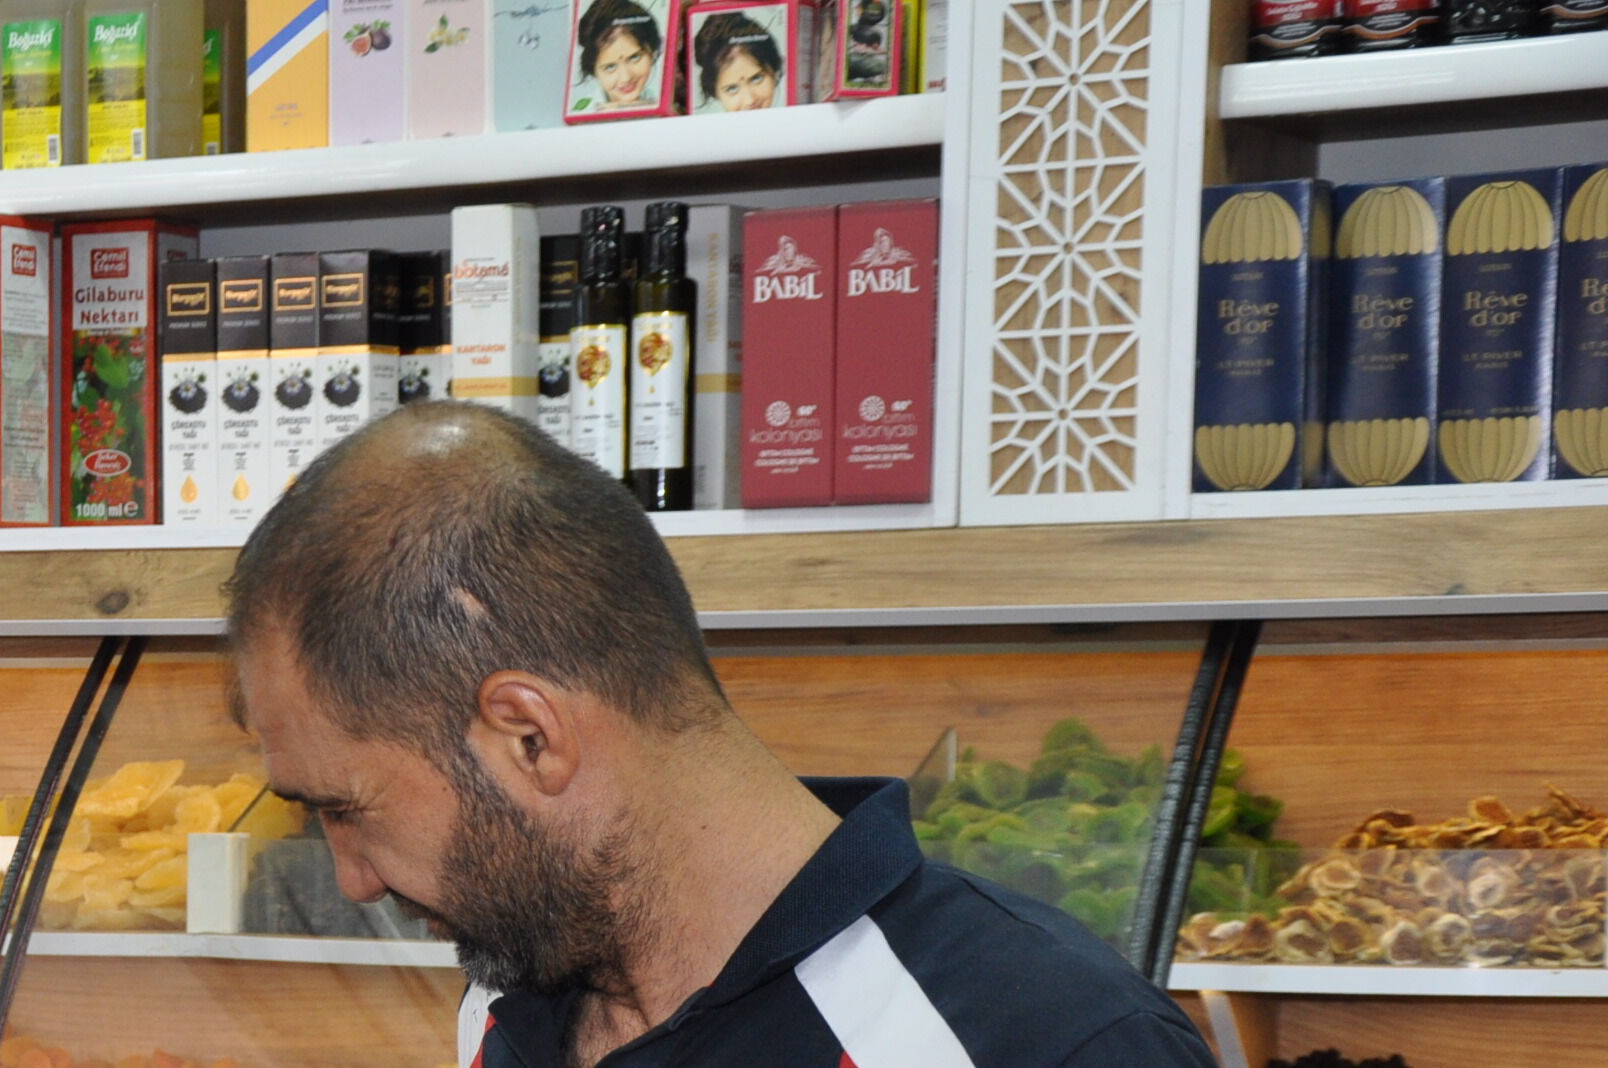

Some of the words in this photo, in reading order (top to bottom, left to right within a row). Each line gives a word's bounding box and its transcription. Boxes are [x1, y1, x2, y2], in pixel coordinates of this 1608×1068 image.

[93, 251, 127, 262] Cemil
[94, 262, 127, 273] Efendi
[75, 286, 144, 303] Gilaburu
[80, 308, 139, 325] Nektarı
[76, 503, 104, 517] 1000
[108, 503, 122, 516] ml
